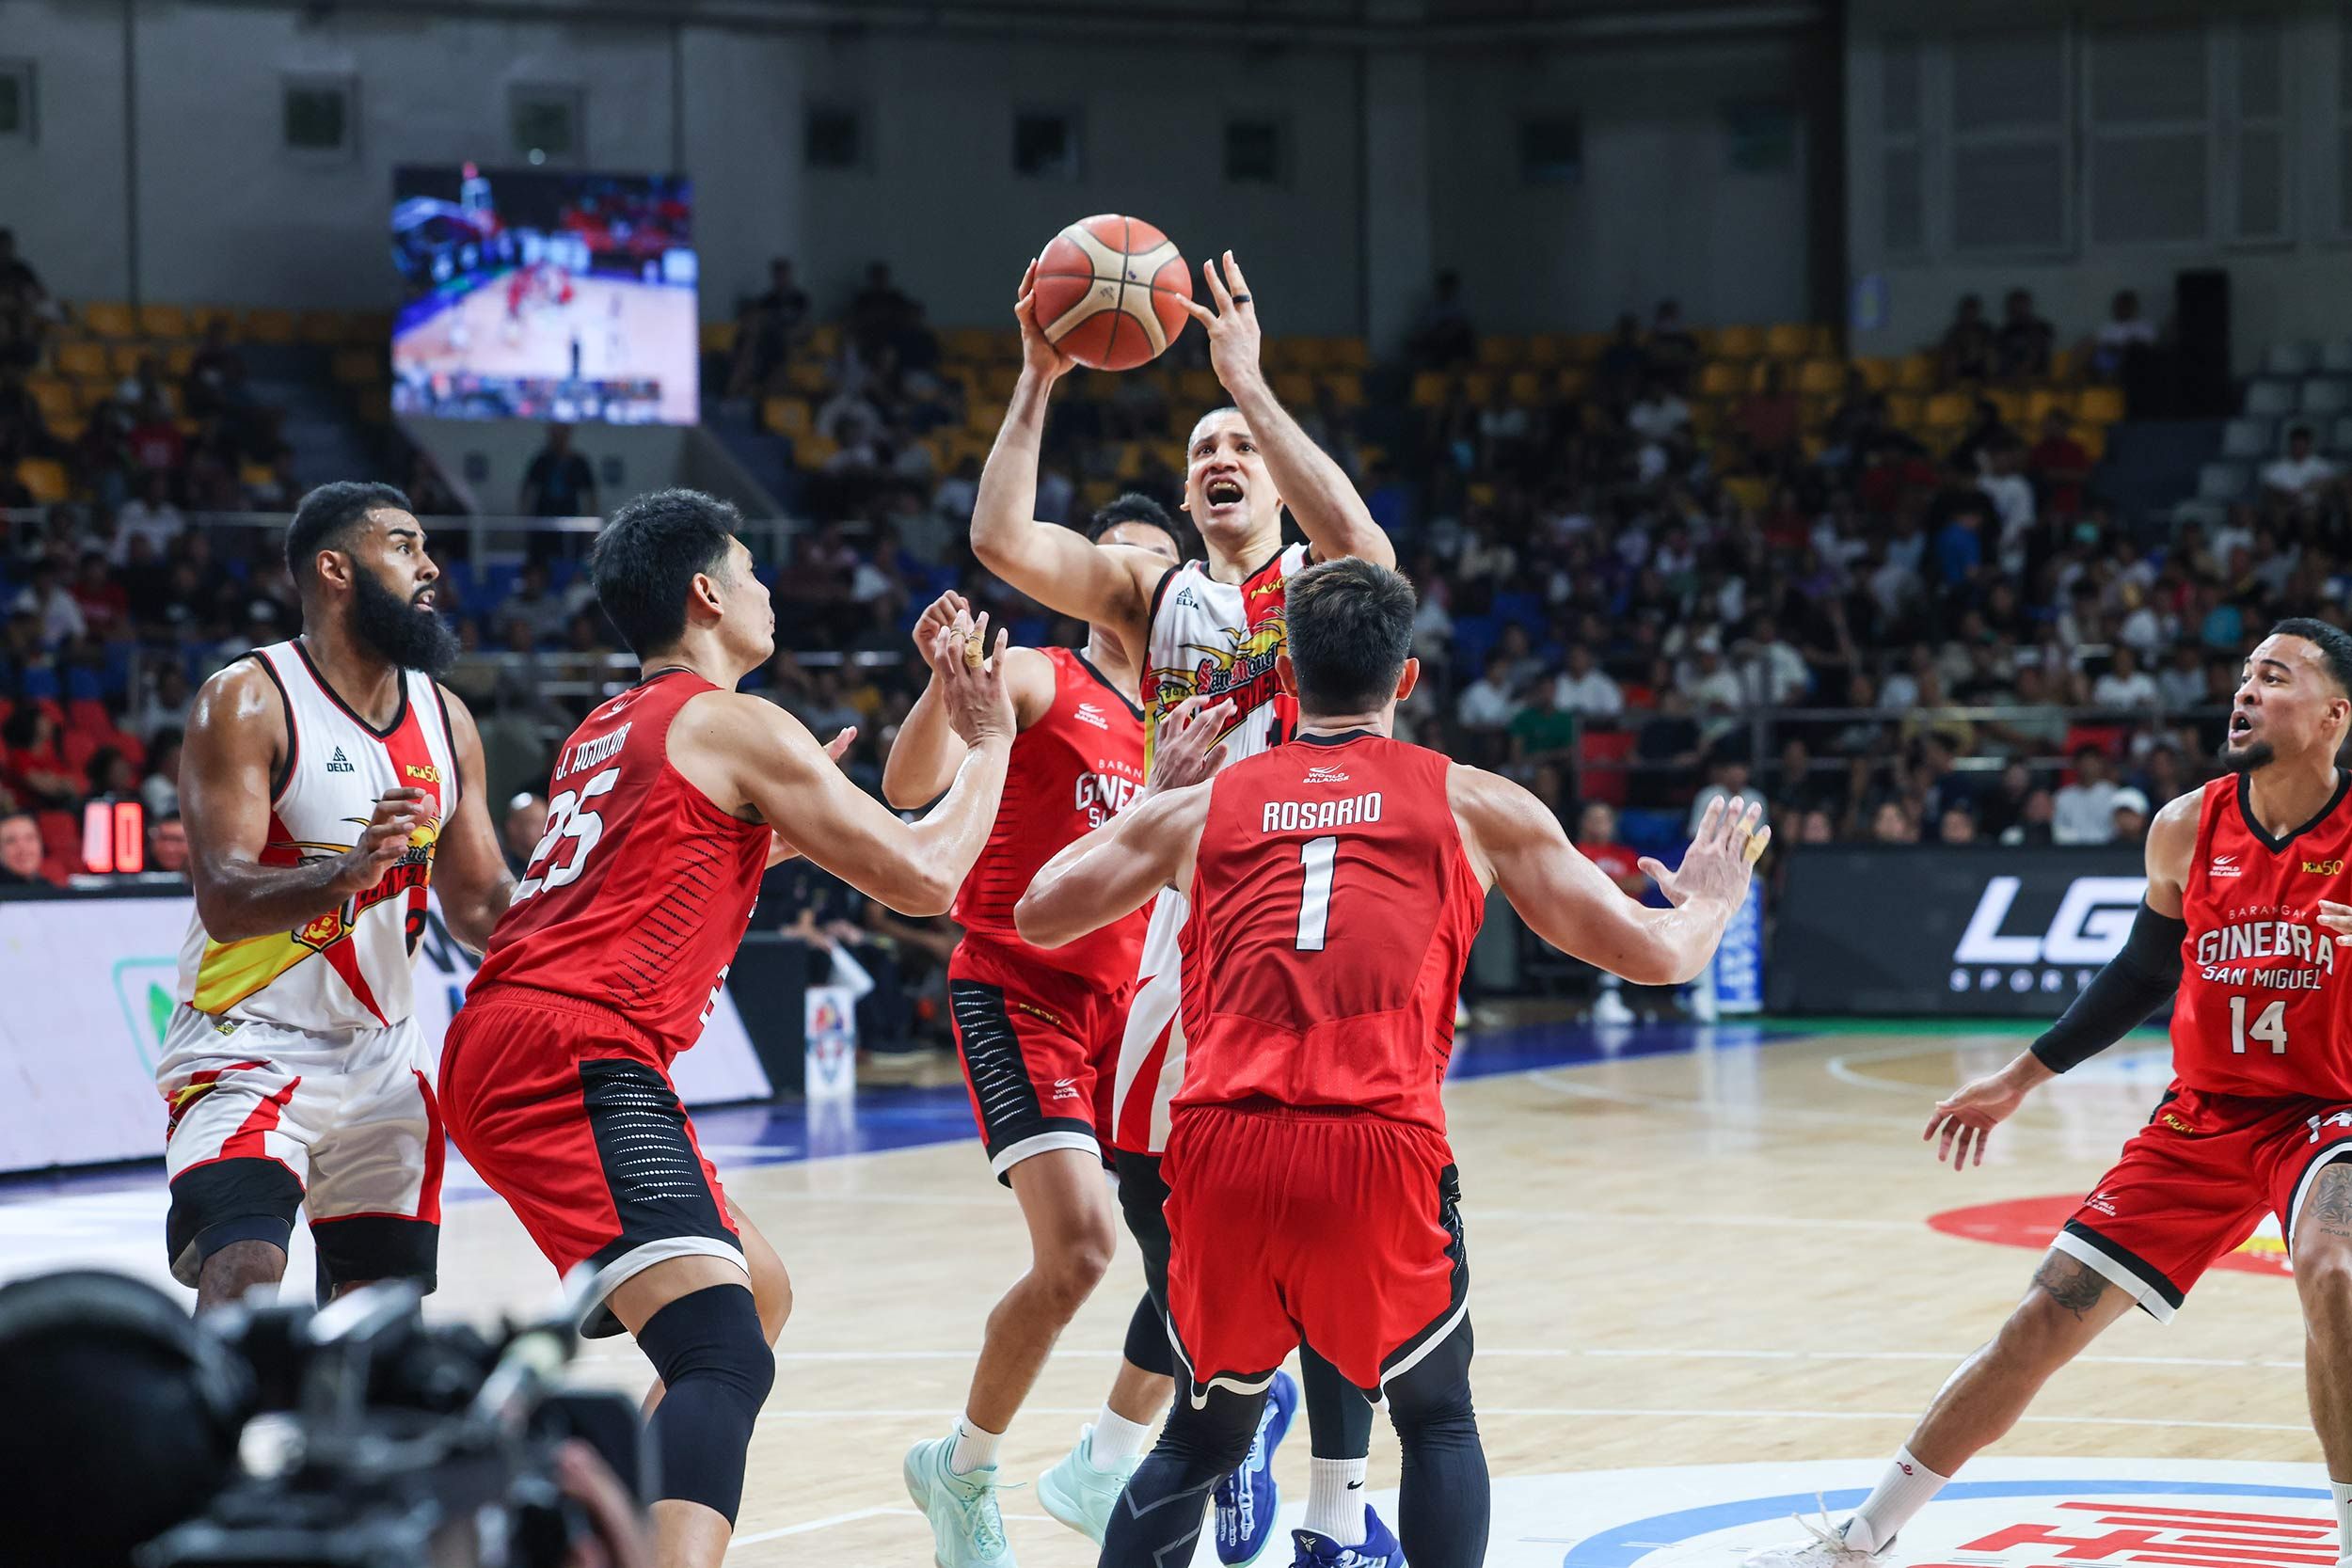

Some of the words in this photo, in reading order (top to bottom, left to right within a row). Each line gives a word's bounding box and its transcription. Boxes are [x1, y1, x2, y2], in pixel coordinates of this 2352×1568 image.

[326, 762, 356, 773] DELTA
[555, 747, 572, 781] J.
[570, 721, 633, 774] AGUILAR
[509, 767, 622, 909] 25
[1262, 791, 1383, 833] ROSARIO
[1295, 834, 1338, 952] 1
[2228, 905, 2308, 921] BARANGAY
[2195, 921, 2335, 976] GINEBRA
[2201, 965, 2247, 987] SAN
[2251, 968, 2323, 990] MIGUEL
[2229, 995, 2288, 1054] 14
